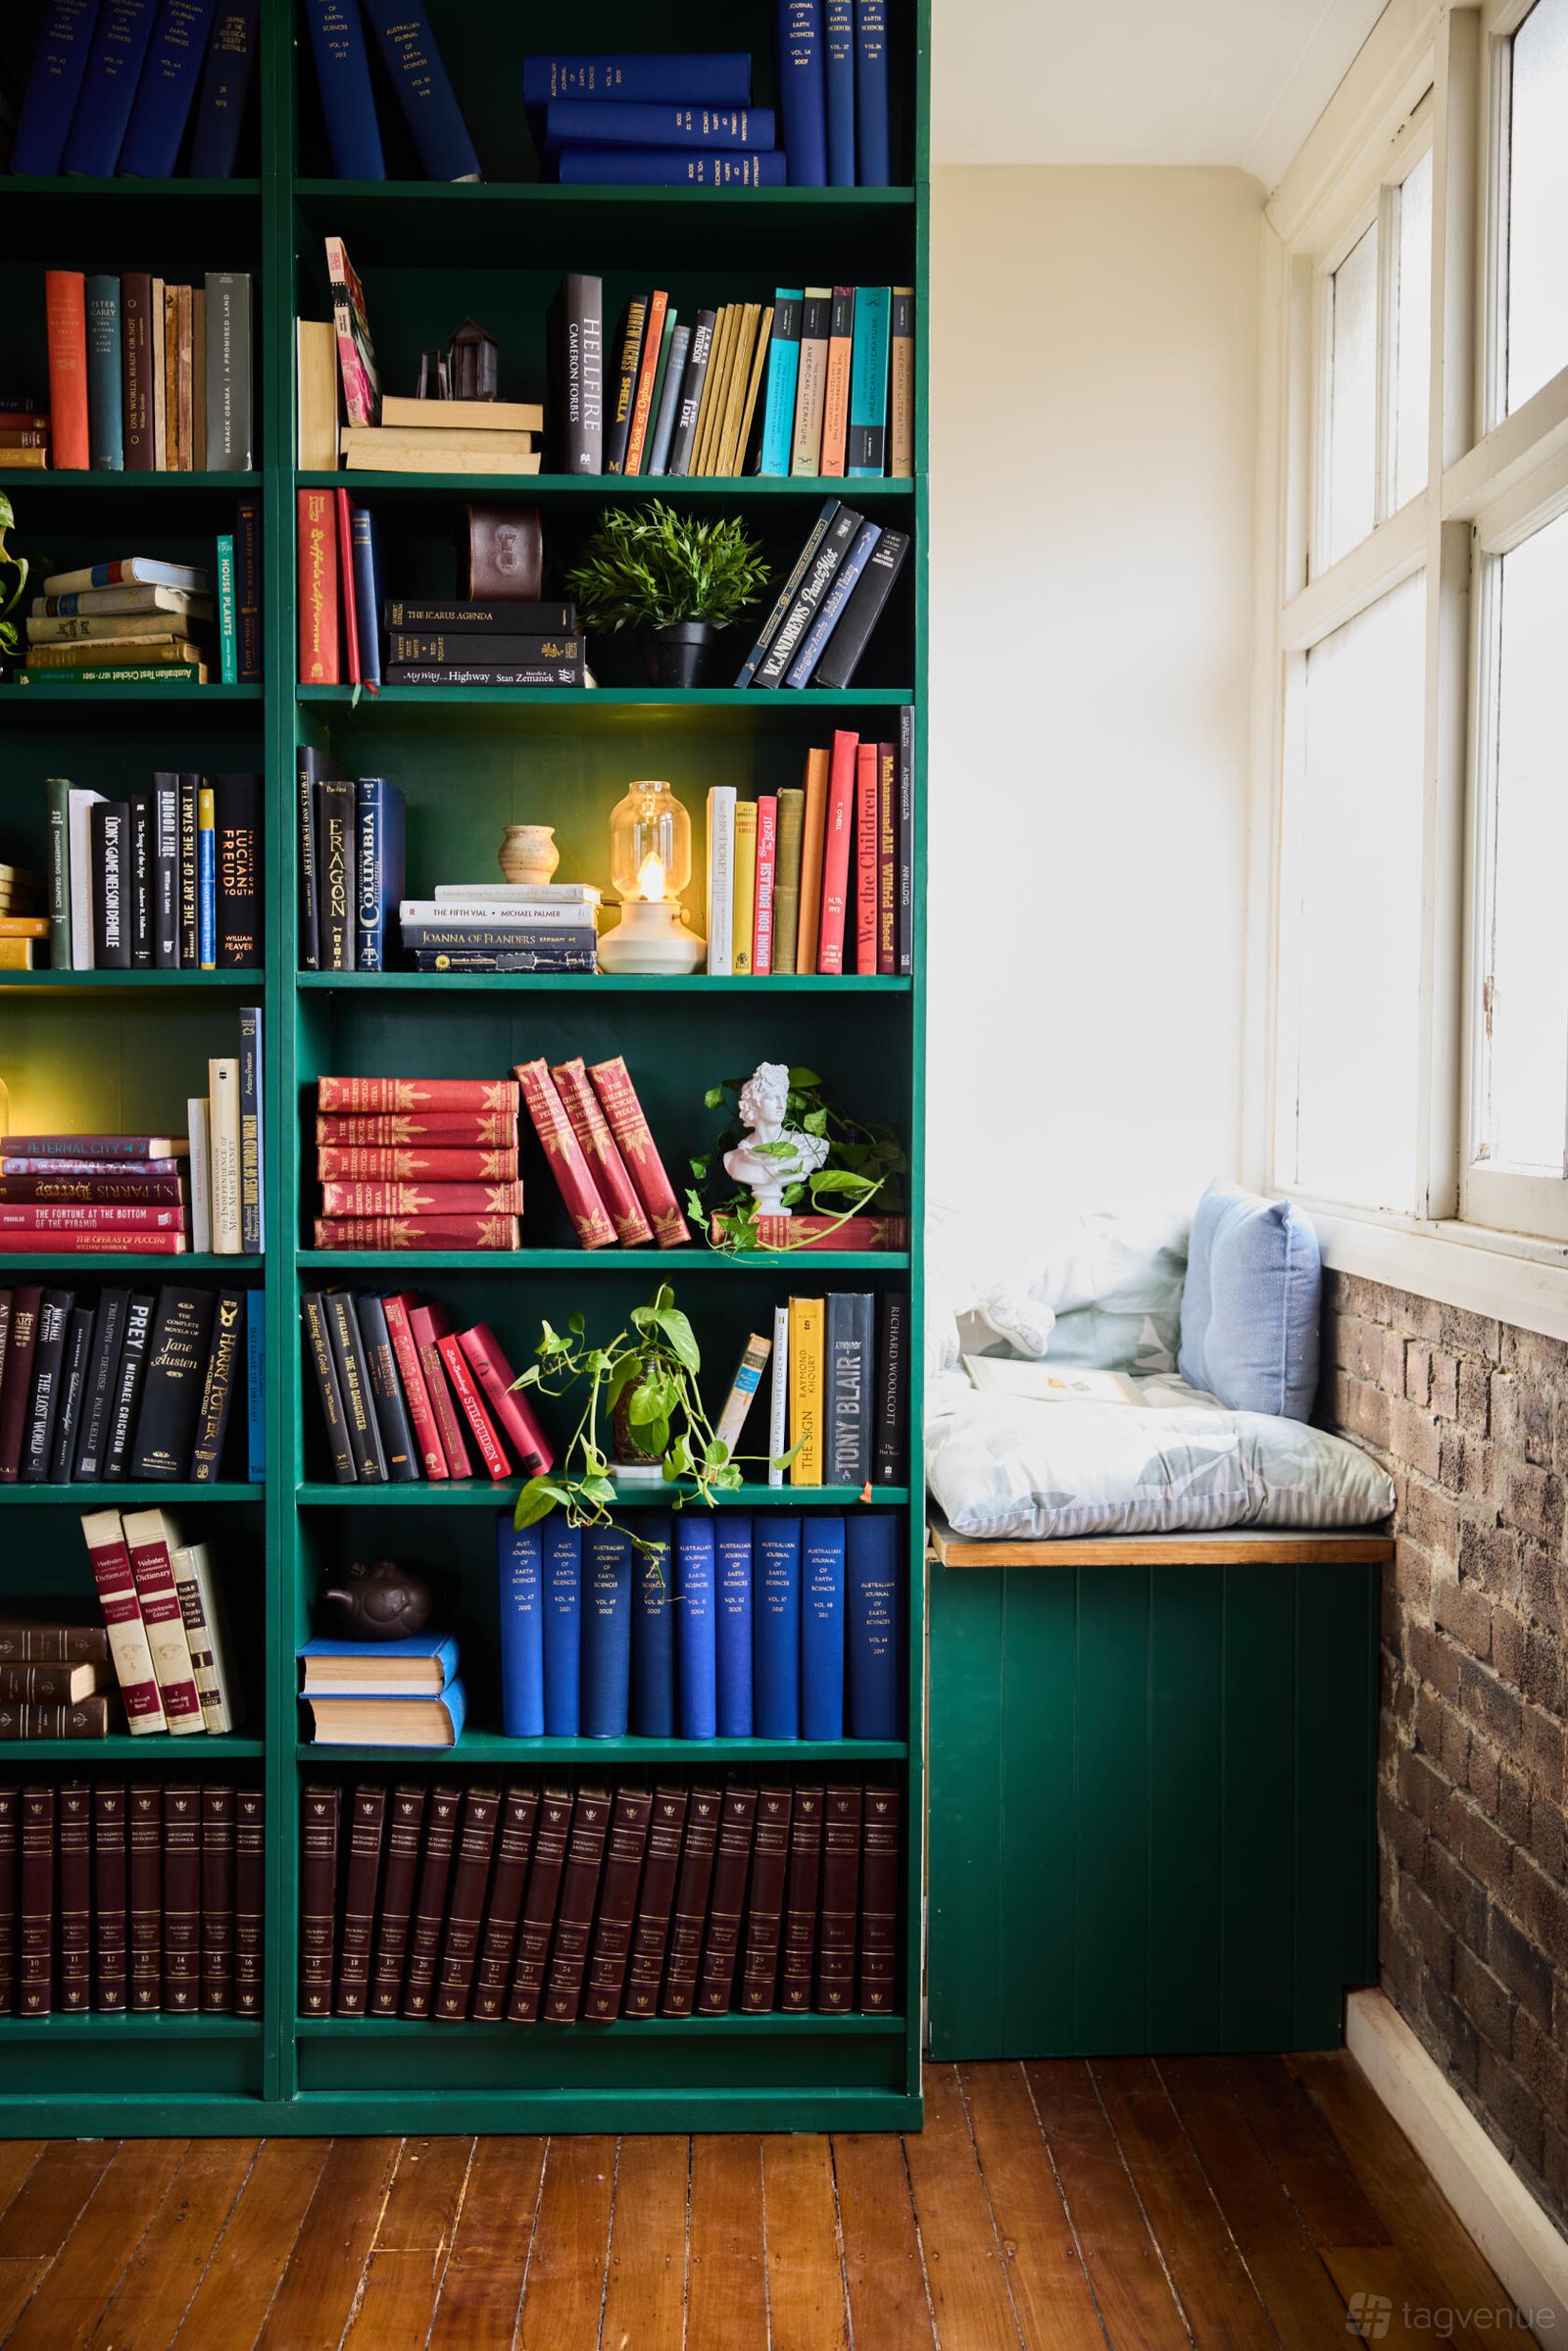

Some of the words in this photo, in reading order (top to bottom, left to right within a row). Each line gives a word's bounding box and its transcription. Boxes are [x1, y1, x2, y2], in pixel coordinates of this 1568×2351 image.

[91, 308, 117, 317] CAREY
[627, 302, 645, 340] ANDREW
[128, 336, 136, 349] OR
[568, 322, 579, 379] CAMERON
[621, 340, 640, 372] VACHSS
[692, 325, 706, 365] PATTERSON
[702, 328, 711, 365] JAMES
[583, 318, 600, 431] HELLFIRE
[804, 345, 812, 392] AMERICAN
[570, 380, 579, 422] FORBES
[616, 376, 631, 422] SHELLA
[639, 371, 651, 409] Ogham
[800, 393, 810, 446] LITERATURE
[631, 428, 642, 449] Book
[628, 453, 638, 472] The
[220, 559, 231, 593] HOUSE
[816, 547, 839, 578] Mist
[222, 596, 232, 636] PLANTS
[408, 611, 423, 619] THE
[424, 611, 455, 620] ICARUS
[457, 612, 494, 620] AGENDA
[793, 636, 818, 680] Kingsley
[836, 563, 858, 590] Thing
[112, 670, 139, 680] Cricket
[139, 669, 154, 679] Test
[155, 668, 191, 679] Australian
[403, 672, 420, 683] My
[448, 671, 490, 684] Highway
[496, 673, 514, 683] Stan
[515, 673, 554, 683] Zemanek
[300, 770, 309, 806] JEWELS
[881, 755, 894, 831] Muhammad
[162, 791, 175, 832] DRAGON
[182, 796, 194, 832] START
[859, 787, 875, 869] Children
[882, 832, 894, 854] Ali
[105, 848, 120, 874] GAME
[162, 835, 175, 857] FIRE
[182, 835, 194, 857] THE
[221, 829, 235, 888] FREUD
[235, 829, 248, 889] LUCIAN
[303, 822, 313, 877] JEWELLERY
[183, 860, 194, 875] OF
[328, 818, 347, 917] ERAGON
[105, 874, 120, 906] NELSON
[183, 878, 194, 901] ART
[759, 861, 772, 908] BOULASH
[861, 875, 875, 905] the
[882, 862, 894, 908] Wilfrid
[105, 906, 120, 948] DEMILLE
[183, 904, 194, 926] THE
[759, 910, 769, 931] BON
[882, 911, 894, 951] Sheed
[467, 933, 482, 943] OF
[757, 934, 769, 968] BIMINI
[243, 1120, 257, 1139] WAR
[33, 1142, 87, 1153] ETERNAL
[90, 1142, 120, 1153] CITY
[227, 1139, 236, 1175] BENNET
[243, 1139, 258, 1167] WORLD
[244, 1167, 258, 1177] OF
[98, 1184, 149, 1199] PARRIS
[228, 1178, 237, 1205] MARY
[244, 1177, 259, 1203] NAVIES
[35, 1209, 48, 1218] THE
[52, 1209, 85, 1219] FORTUNE
[87, 1209, 98, 1219] AT
[101, 1209, 114, 1219] THE
[117, 1209, 147, 1219] BOTTOM
[35, 1219, 45, 1228] OF
[48, 1219, 61, 1228] THE
[65, 1219, 98, 1229] PYRAMID
[228, 1208, 237, 1231] MISS
[135, 1235, 166, 1244] PUCCINI
[40, 1303, 54, 1343] CRICHTON
[49, 1307, 63, 1343] MICHAEL
[104, 1302, 118, 1344] TRIUMPH
[126, 1305, 149, 1349] PREY
[164, 1326, 189, 1335] NOVELS
[167, 1319, 200, 1329] COMPLETE
[308, 1303, 320, 1339] Battling
[337, 1315, 350, 1347] FIELDING
[888, 1306, 900, 1358] RICHARD
[151, 1353, 197, 1370] Austen
[161, 1338, 193, 1353] Jane
[215, 1332, 236, 1383] HARRY
[315, 1339, 323, 1352] the
[97, 1356, 110, 1392] DEMISE
[318, 1354, 328, 1374] Gods
[344, 1355, 356, 1371] THE
[377, 1344, 397, 1396] BRIMSTONE
[38, 1373, 52, 1393] THE
[121, 1363, 136, 1403] MICHAEL
[348, 1372, 360, 1388] BAD
[836, 1355, 861, 1415] BLAIR
[886, 1362, 898, 1426] WOOLCOTT
[35, 1394, 50, 1419] LOST
[92, 1396, 103, 1419] PAUL
[204, 1384, 228, 1441] POTTER
[350, 1389, 367, 1431] DAUGHTER
[30, 1420, 46, 1454] WORLD
[87, 1419, 100, 1451] KELLY
[114, 1406, 129, 1453] CRICHTON
[802, 1410, 813, 1441] SIGN
[802, 1445, 813, 1469] THE
[835, 1420, 860, 1472] TONY
[95, 1570, 129, 1583] Dictionary
[135, 1569, 171, 1583] Dictionary
[137, 1555, 166, 1566] Webster
